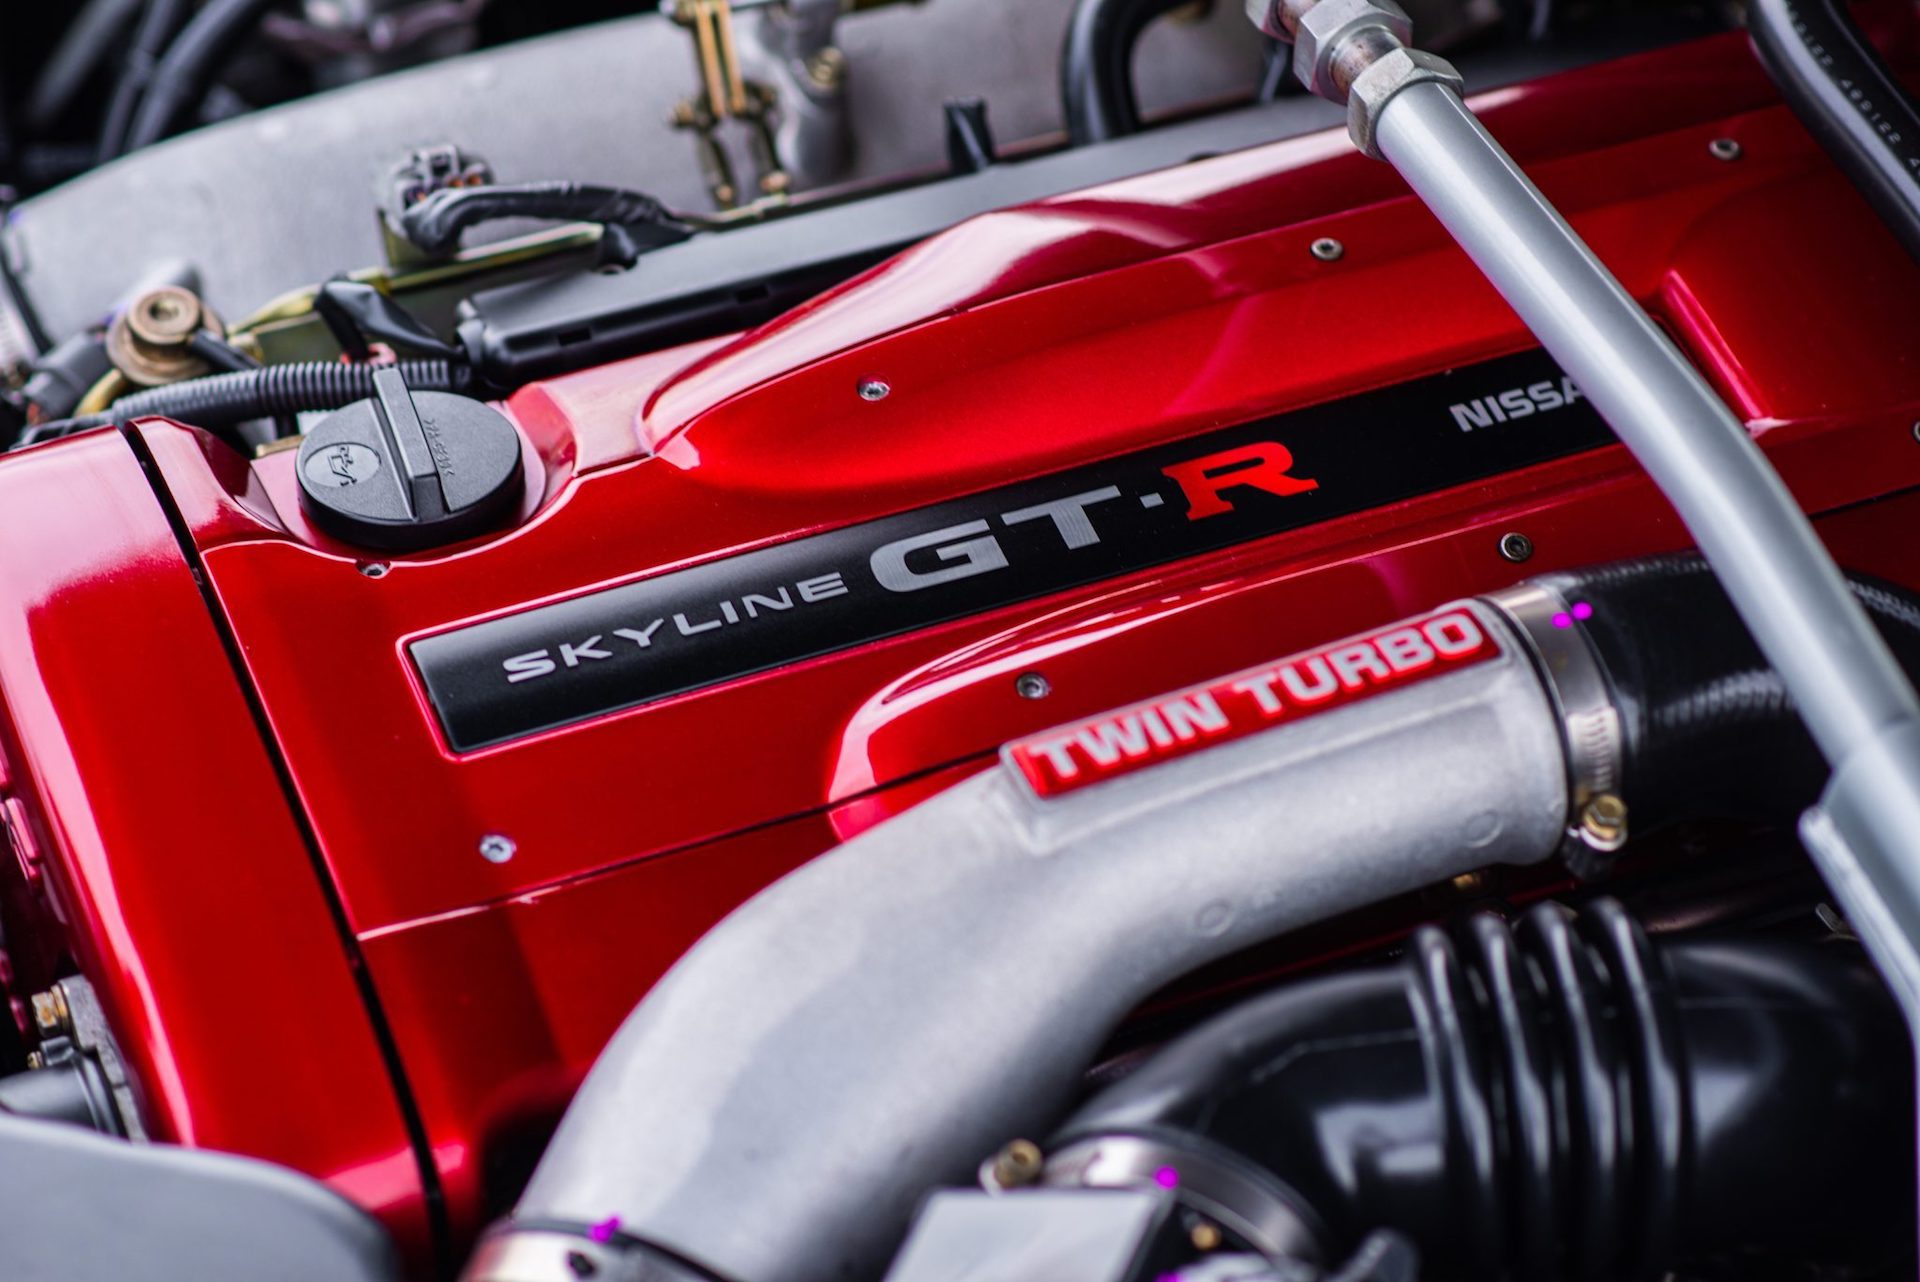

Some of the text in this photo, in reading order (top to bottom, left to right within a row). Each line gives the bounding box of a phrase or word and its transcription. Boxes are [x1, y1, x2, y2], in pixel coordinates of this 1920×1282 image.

[1449, 376, 1585, 433] NISSA
[502, 572, 849, 684] SKYLINE
[1028, 612, 1485, 780] TWIN TURBO
